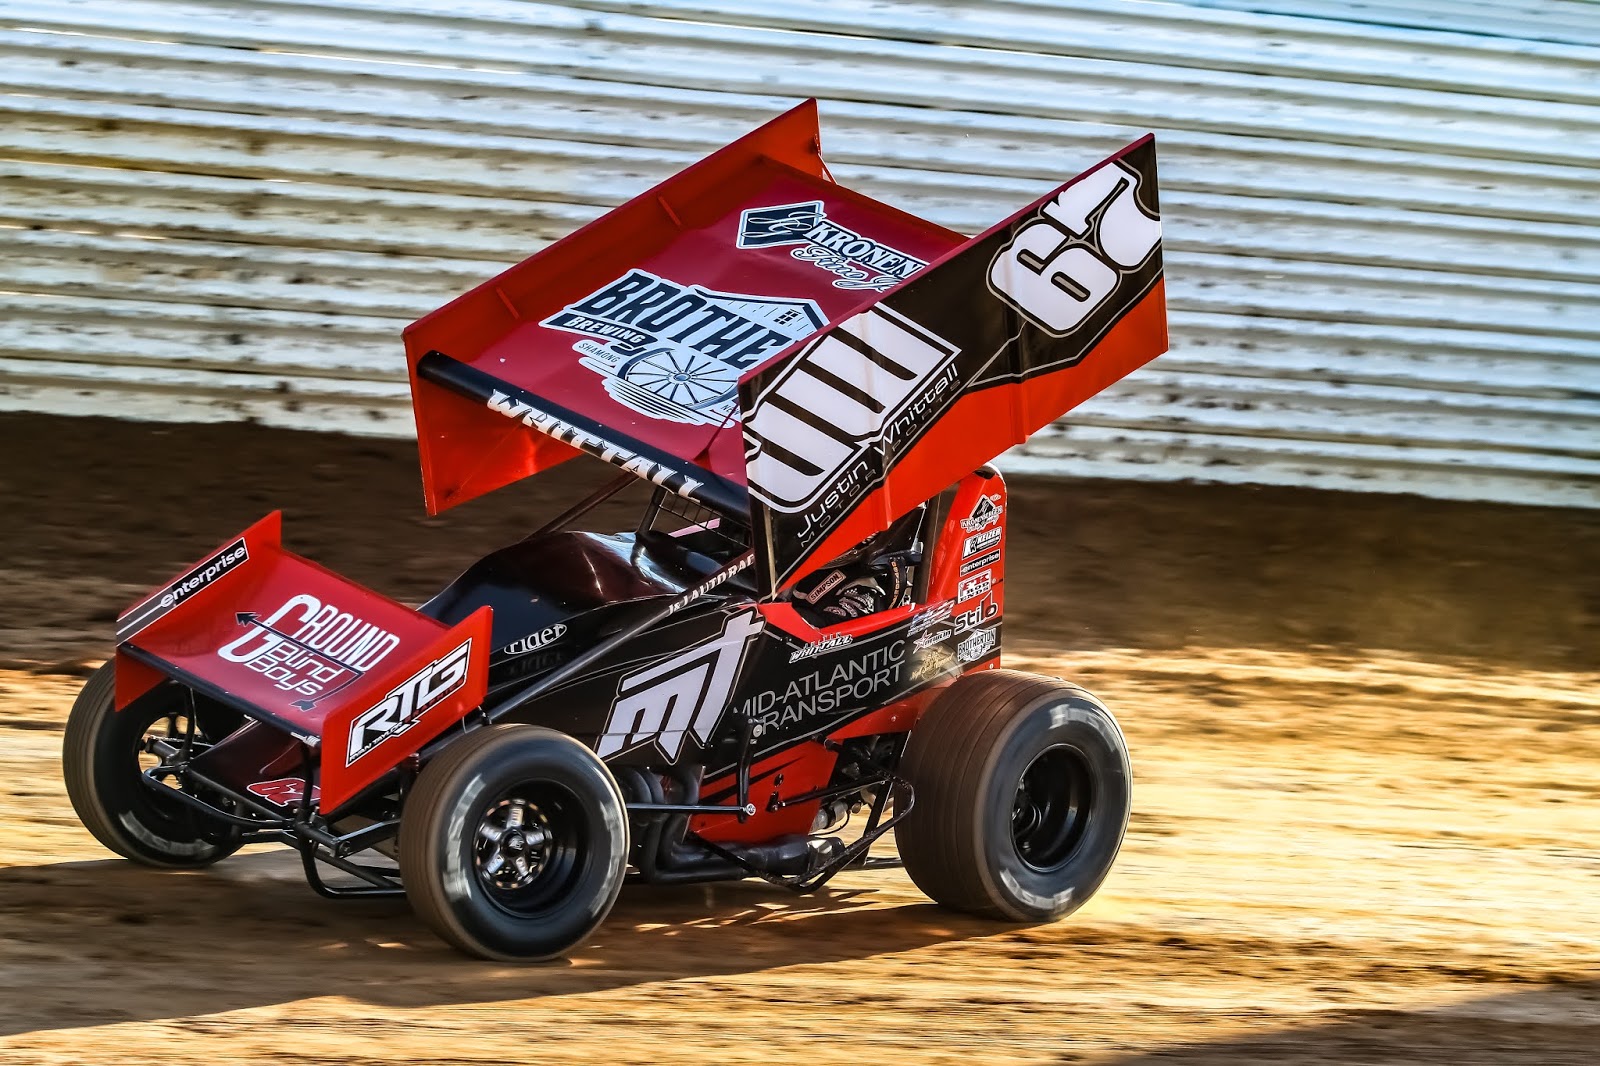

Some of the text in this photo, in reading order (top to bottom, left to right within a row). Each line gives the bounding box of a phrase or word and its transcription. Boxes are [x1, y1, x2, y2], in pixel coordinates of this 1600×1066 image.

[990, 164, 1162, 332] 67
[564, 316, 647, 344] BREWING
[571, 272, 792, 369] BROTHE
[578, 341, 621, 364] SHAMONG
[487, 389, 704, 499] WHITTALL
[797, 460, 869, 539] Justin
[873, 363, 958, 456] Whittall
[160, 545, 246, 608] enterprise
[962, 553, 1000, 574] enterprise
[690, 571, 727, 602] AUTO
[810, 573, 840, 600] SIMPSON
[960, 587, 989, 602] ENDS
[966, 581, 990, 594] ROD
[265, 641, 346, 683] Blind
[959, 629, 995, 653] BROTHERTON
[244, 654, 324, 696] Boys
[349, 643, 469, 757] RTG
[760, 660, 906, 735] RANSPORT
